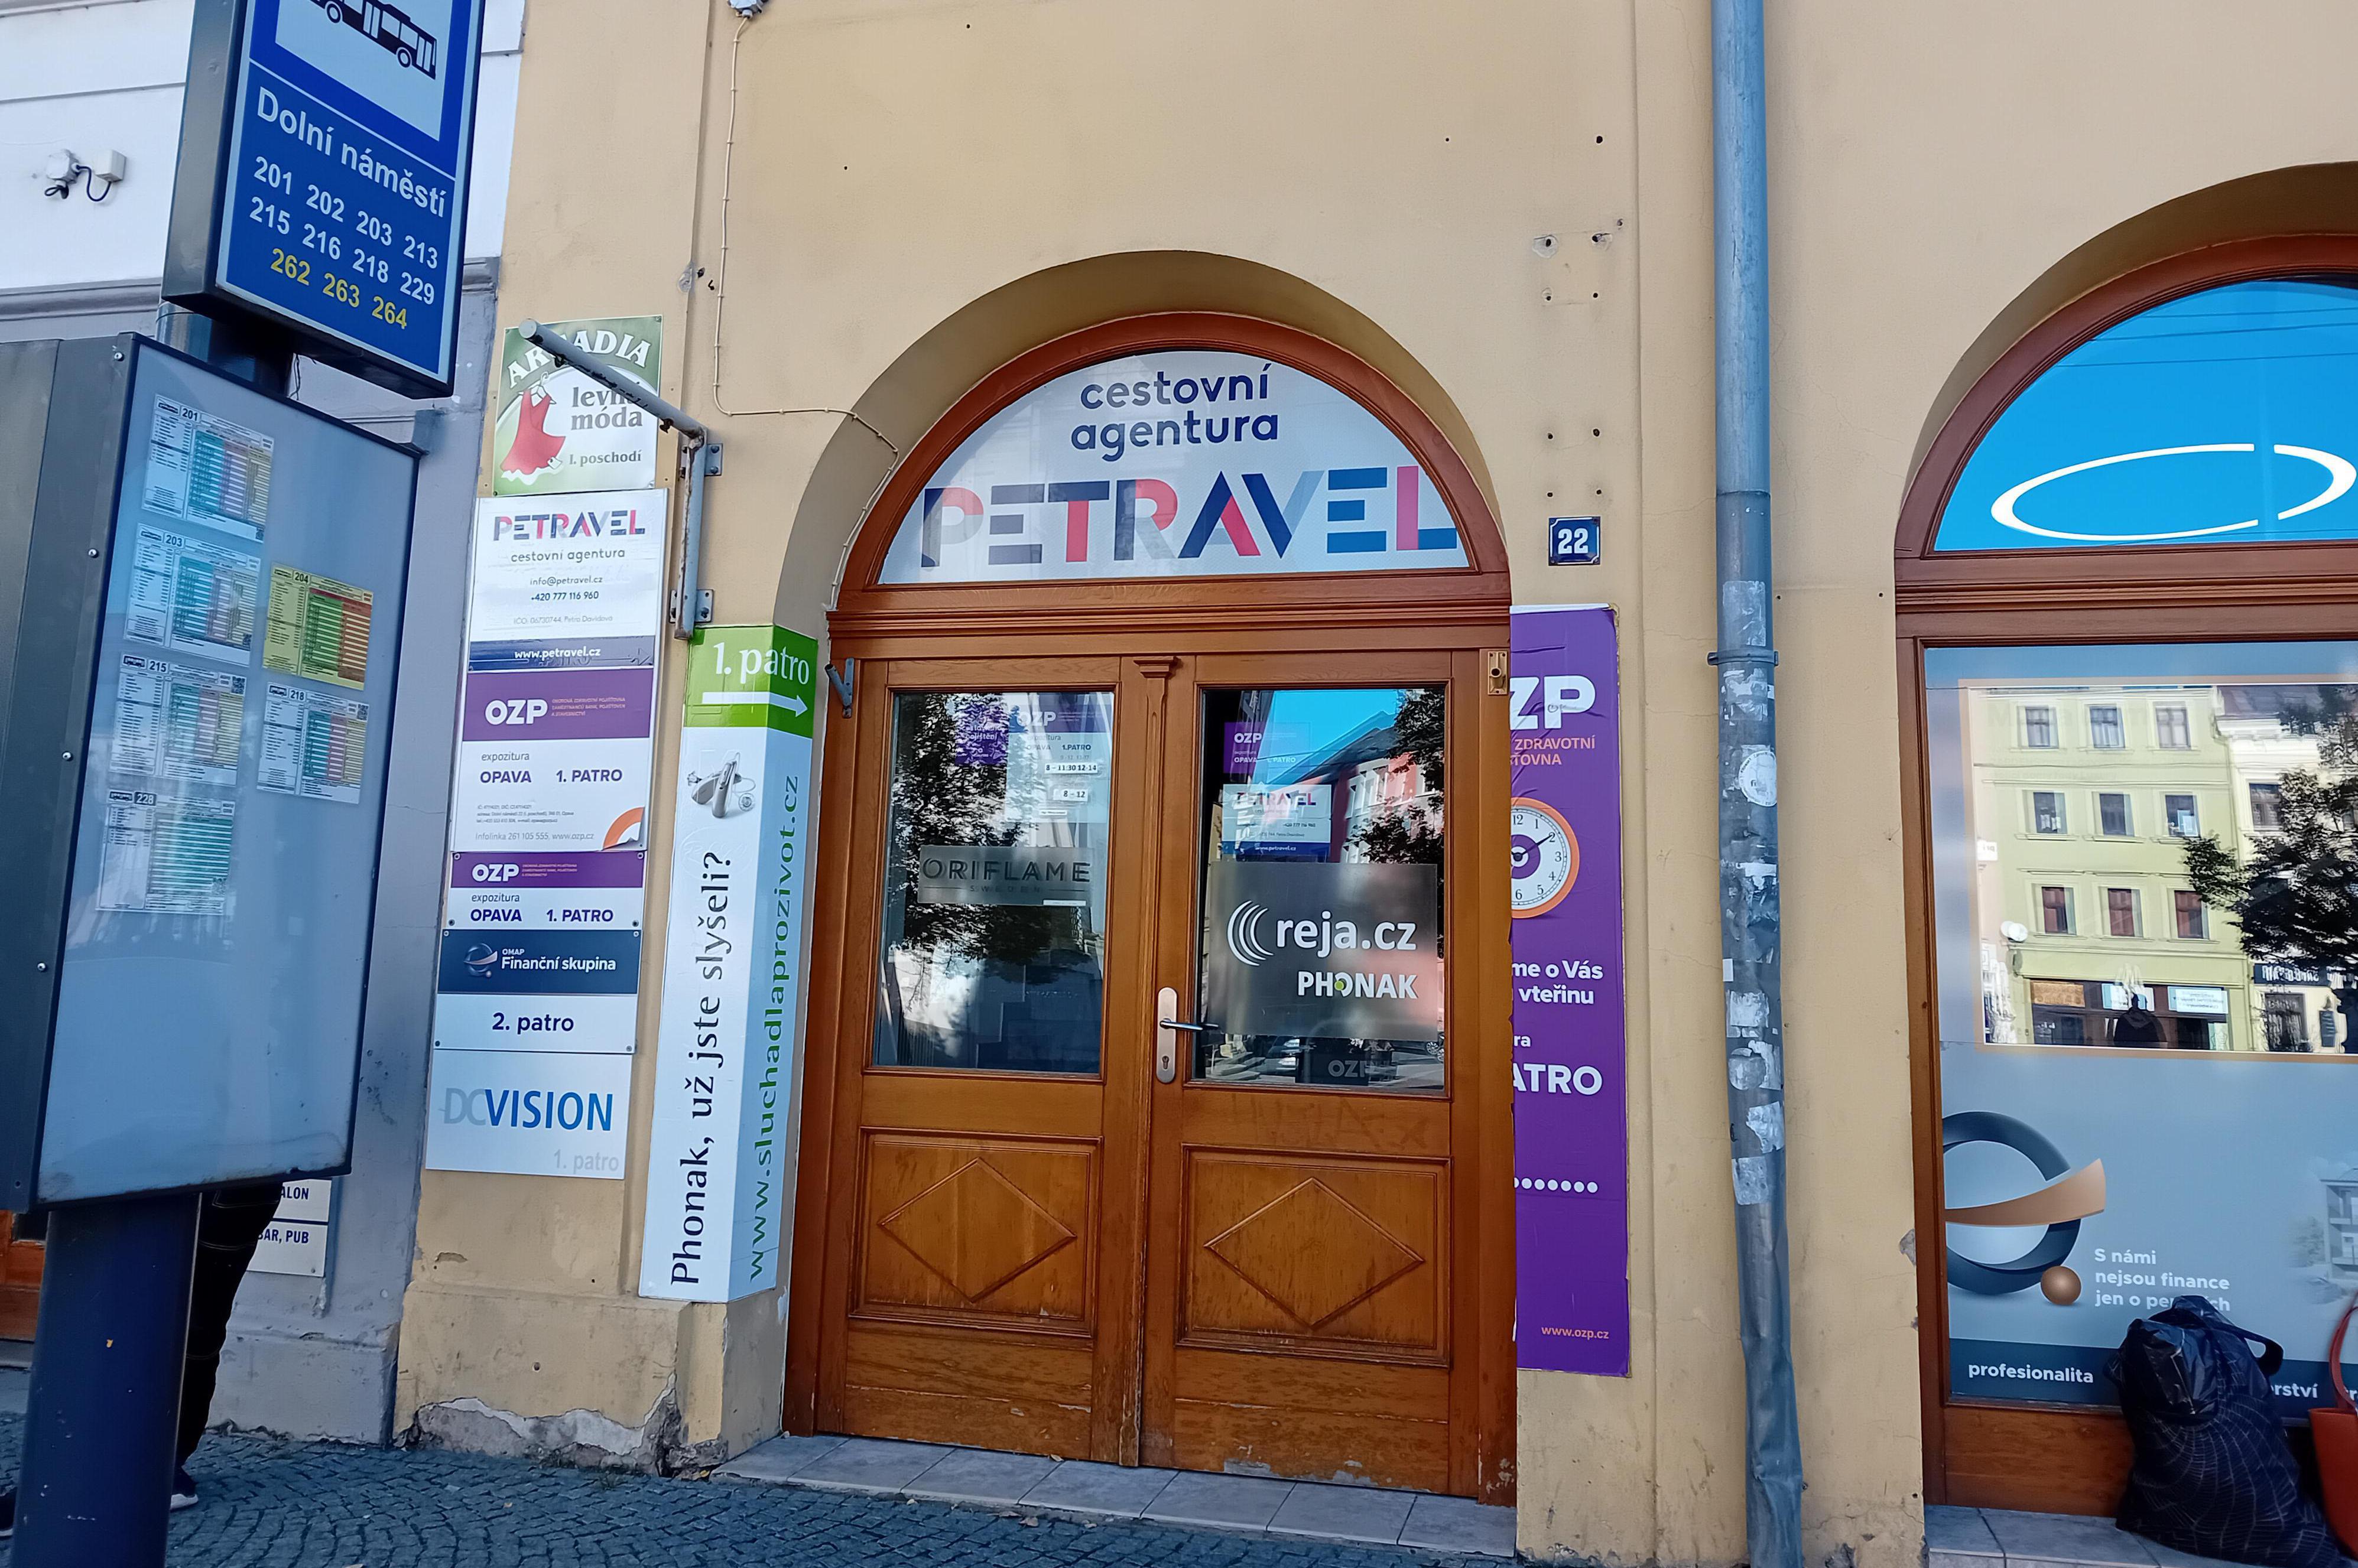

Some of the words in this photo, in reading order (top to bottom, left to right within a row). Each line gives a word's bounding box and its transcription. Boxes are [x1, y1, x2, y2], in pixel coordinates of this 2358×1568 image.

[258, 86, 334, 157] Dolní
[341, 142, 446, 218] náměstí
[254, 156, 292, 195] 201
[306, 184, 345, 222] 202
[356, 211, 392, 246] 203
[403, 235, 439, 269] 213
[249, 196, 291, 235] 215
[302, 223, 342, 260] 216
[352, 248, 389, 283] 218
[400, 271, 435, 305] 229
[271, 248, 310, 286] 262
[322, 272, 360, 308] 263
[372, 297, 408, 330] 264
[1080, 363, 1269, 410] cestovní
[572, 386, 634, 408] levn
[183, 408, 198, 421] 201
[571, 406, 643, 431] móda
[1071, 411, 1279, 463] agentura
[580, 449, 642, 467] poschodí
[493, 510, 645, 541] PETRAVEL
[921, 465, 1457, 568] PETRAVEL
[166, 535, 182, 548] 203
[1558, 528, 1589, 554] 22
[511, 549, 563, 562] cestovní
[567, 548, 625, 562] agentura
[295, 572, 310, 584] 204
[530, 575, 603, 587] info@petravel.cz
[531, 593, 550, 601] +420
[553, 592, 566, 600] 777
[569, 591, 581, 600] 116
[583, 591, 599, 599] 960
[514, 646, 601, 661] www.petravel.cz
[150, 661, 167, 672] 215
[713, 642, 732, 675] 1.
[739, 646, 810, 685] patro
[290, 690, 305, 701] 218
[485, 698, 548, 726] OZP
[1016, 711, 1056, 726] OZP
[1234, 732, 1262, 744] OZP
[1515, 735, 1596, 750] ZDRAVOTNÍ
[481, 751, 530, 762] expozitura
[1510, 752, 1562, 766] ŤOVNA
[480, 770, 532, 783] OPAVA
[556, 770, 567, 782] 1.
[571, 769, 623, 782] PATRO
[137, 793, 154, 804] 228
[1512, 814, 1524, 825] 12
[1535, 819, 1538, 829] 1
[522, 832, 534, 840] 105
[552, 832, 595, 841] www.ozp.cz
[1548, 832, 1555, 842] 2
[1555, 851, 1561, 862] 3
[471, 863, 520, 883] OZP
[923, 857, 1091, 883] ORIFLAME
[1548, 871, 1556, 881] 4
[1515, 889, 1522, 900] 6
[1538, 884, 1544, 894] 5
[471, 893, 520, 904] expozitura
[470, 909, 522, 922] OPAVA
[546, 909, 558, 922] 1.
[562, 909, 613, 923] PATRO
[695, 851, 732, 980] slyšeli?
[1277, 911, 1417, 958] reja.cz
[501, 955, 560, 971] Finanční
[561, 958, 616, 973] skupina
[1545, 964, 1560, 978] o
[1561, 960, 1603, 979] Vás
[1298, 971, 1418, 998] PHONAK
[1518, 984, 1594, 1004] vteřinu
[492, 1012, 510, 1031] 2.
[517, 1013, 574, 1035] patro
[688, 996, 723, 1069] jste
[750, 775, 798, 1282] www.sluchadlaprozivot.cz
[684, 1076, 714, 1119] už
[443, 1087, 613, 1132] DCVISION
[553, 1149, 567, 1169] 1.
[573, 1151, 619, 1174] patro
[671, 1137, 714, 1285] Phonak,
[286, 1231, 309, 1244] PUB
[2094, 1248, 2106, 1262] S
[2112, 1249, 2156, 1264] námi
[2096, 1270, 2155, 1287] nejsou
[2161, 1271, 2230, 1290] finance
[2095, 1290, 2123, 1307] jen
[2129, 1296, 2141, 1306] o
[1541, 1326, 1610, 1340] www.ozp.cz
[1969, 1362, 2094, 1384] profesionalita
[2271, 1382, 2318, 1398] rství
